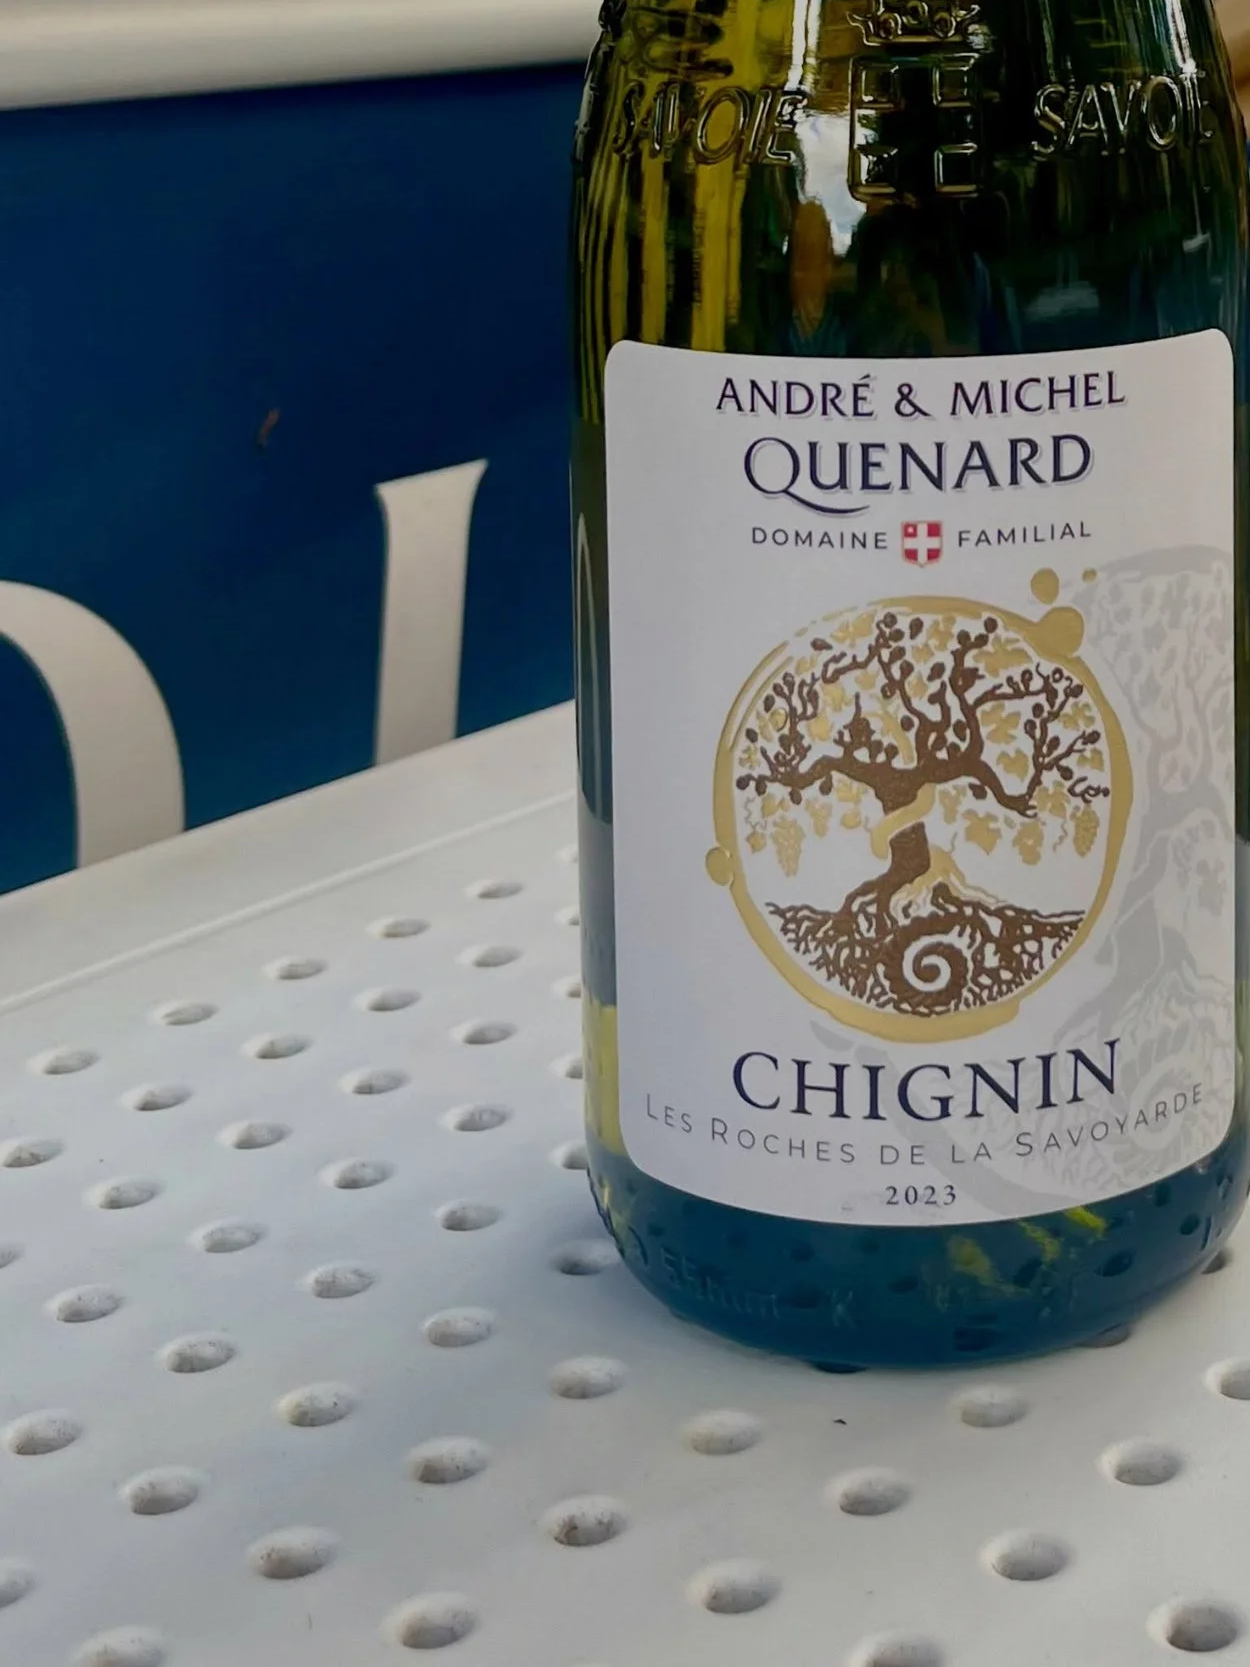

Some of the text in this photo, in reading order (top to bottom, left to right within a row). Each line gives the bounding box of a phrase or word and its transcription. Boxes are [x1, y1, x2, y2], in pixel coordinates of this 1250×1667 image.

[715, 370, 1126, 418] ANDRÉ & MICHEL
[743, 433, 1092, 514] QUENARD
[751, 520, 1092, 550] DOMAINE FAMILIAL
[732, 1037, 1121, 1122] CHIGNIN
[646, 1082, 1203, 1166] LES ROCHES DE LA SAVOYARDE
[885, 1185, 957, 1206] 2023
